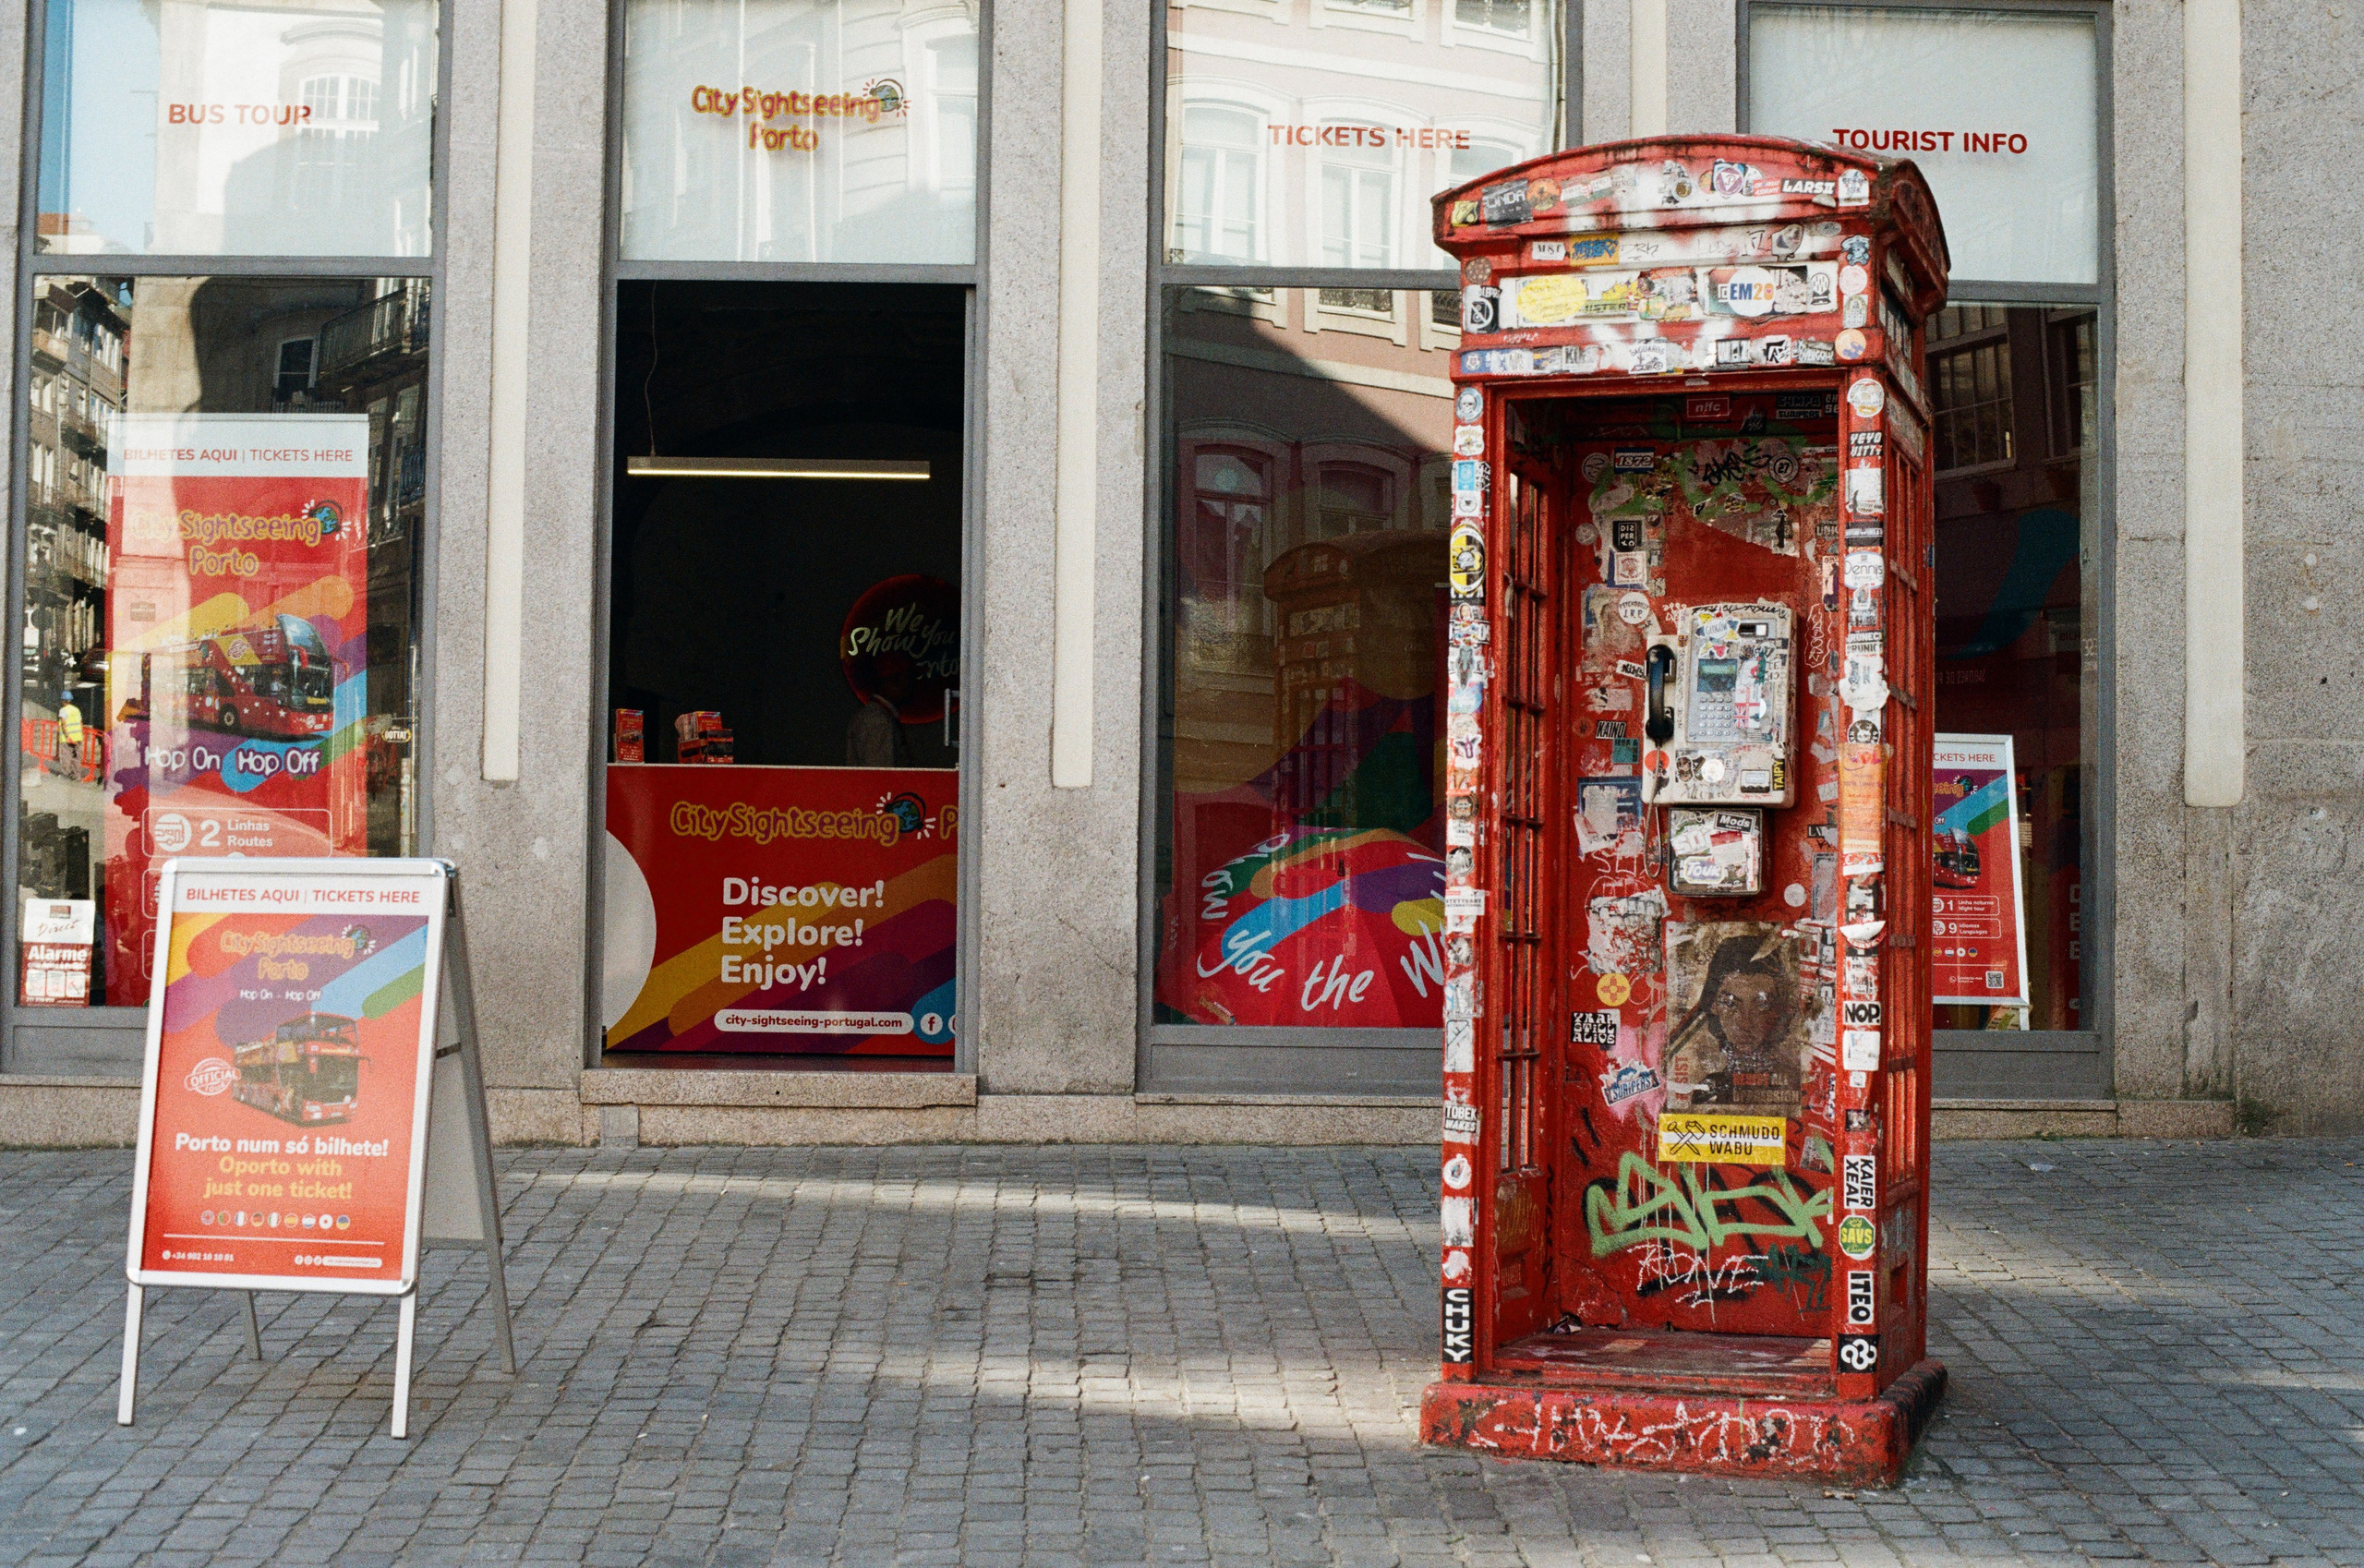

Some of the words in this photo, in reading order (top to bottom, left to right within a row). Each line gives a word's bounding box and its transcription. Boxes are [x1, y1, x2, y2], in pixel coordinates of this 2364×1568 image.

[168, 103, 224, 125] BUS
[237, 104, 311, 126] TOUR
[693, 85, 739, 117] City
[742, 87, 882, 123] Sightseeing
[749, 122, 818, 151] Porto
[1267, 125, 1384, 148] TICKETS
[1396, 128, 1470, 150] HERE
[1833, 128, 1955, 152] TOURIST
[1963, 133, 2027, 154] INFO
[124, 449, 195, 461] BILHETES
[199, 450, 237, 463] AQUI
[250, 450, 309, 462] TICKETS
[314, 450, 353, 462] HERE
[1618, 455, 1651, 466] 1872
[1779, 463, 1790, 474] 27
[179, 510, 321, 547] Sightseeing
[189, 546, 259, 576] Porto
[1845, 561, 1883, 575] Dennis
[885, 601, 924, 633] We
[848, 626, 917, 657] Show
[908, 619, 956, 658] You
[145, 746, 185, 771] Hop
[192, 747, 220, 770] On
[237, 748, 279, 776] Hop
[286, 747, 320, 773] Off
[1933, 754, 1965, 763] CKETS
[1968, 754, 1996, 763] HERE
[1773, 758, 1785, 790] TAIPY
[227, 819, 271, 831] Linhas
[670, 801, 729, 840] City
[729, 802, 901, 846] Sightseeing
[1719, 815, 1751, 828] Mods
[199, 820, 221, 847] 2
[227, 835, 272, 847] Routes
[187, 888, 256, 901] BILHETES
[260, 889, 299, 904] AQUI
[313, 889, 374, 902] TICKETS
[380, 891, 419, 903] HERE
[723, 877, 884, 908] Discover!
[1947, 900, 1954, 911] 1
[722, 917, 863, 951] Explore!
[1948, 922, 1957, 934] 9
[29, 945, 88, 960] Alarme
[221, 931, 254, 955] City
[253, 931, 355, 959] Sightseeing
[259, 957, 308, 981] Porto
[721, 955, 826, 992] Enjoy!
[1197, 930, 1285, 993] You
[1301, 955, 1374, 1011] the
[240, 989, 258, 1001] Hop
[260, 990, 273, 999] On
[285, 990, 304, 1002] Hop
[307, 990, 321, 1001] Off
[726, 1014, 902, 1030] city-sightseeing-portugal.com
[1847, 1003, 1880, 1024] NOP.
[1573, 1033, 1615, 1043] ALIVE
[190, 1067, 237, 1087] OFFICIAL
[1709, 1124, 1779, 1140] SCHMUDO
[175, 1133, 231, 1152] Porto
[237, 1141, 278, 1153] num
[285, 1136, 308, 1154] só
[315, 1138, 388, 1156] bilhete!
[1709, 1141, 1753, 1155] WABU
[219, 1156, 290, 1176] Oporto
[297, 1159, 342, 1176] with
[203, 1178, 242, 1199] just
[247, 1184, 283, 1197] one
[290, 1181, 352, 1200] ticket!
[1847, 1159, 1860, 1207] XEAL
[1861, 1158, 1874, 1207] KAIER
[1841, 1227, 1873, 1244] SAVS
[1850, 1273, 1871, 1322] ITEO
[1445, 1289, 1473, 1362] CHUKY
